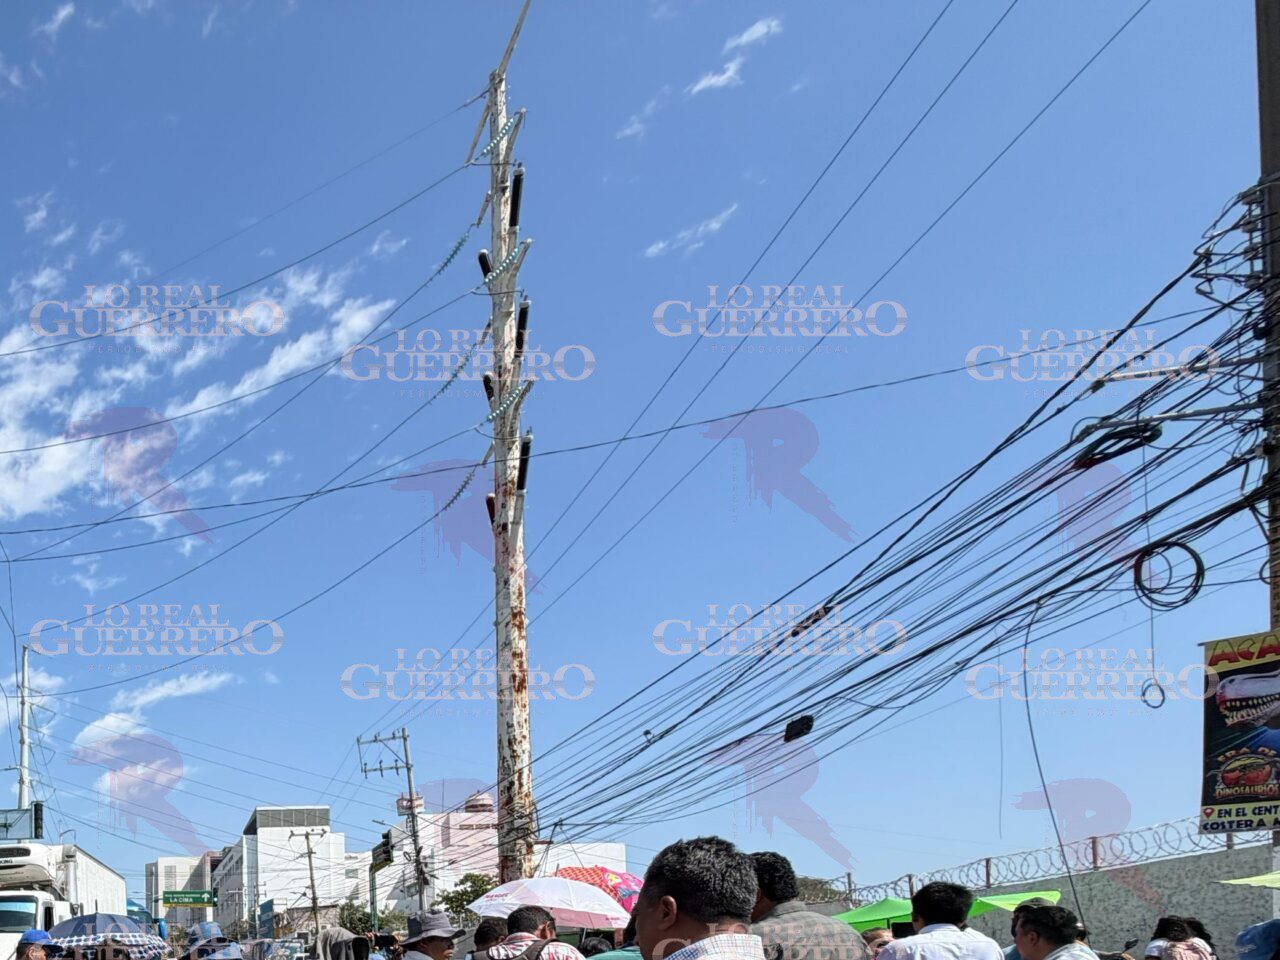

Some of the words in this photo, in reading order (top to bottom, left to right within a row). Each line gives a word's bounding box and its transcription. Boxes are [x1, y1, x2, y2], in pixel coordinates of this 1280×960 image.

[1217, 808, 1232, 818] EN
[1235, 807, 1247, 817] EL
[1252, 804, 1280, 816] CENT
[1203, 818, 1266, 831] COSTERA
